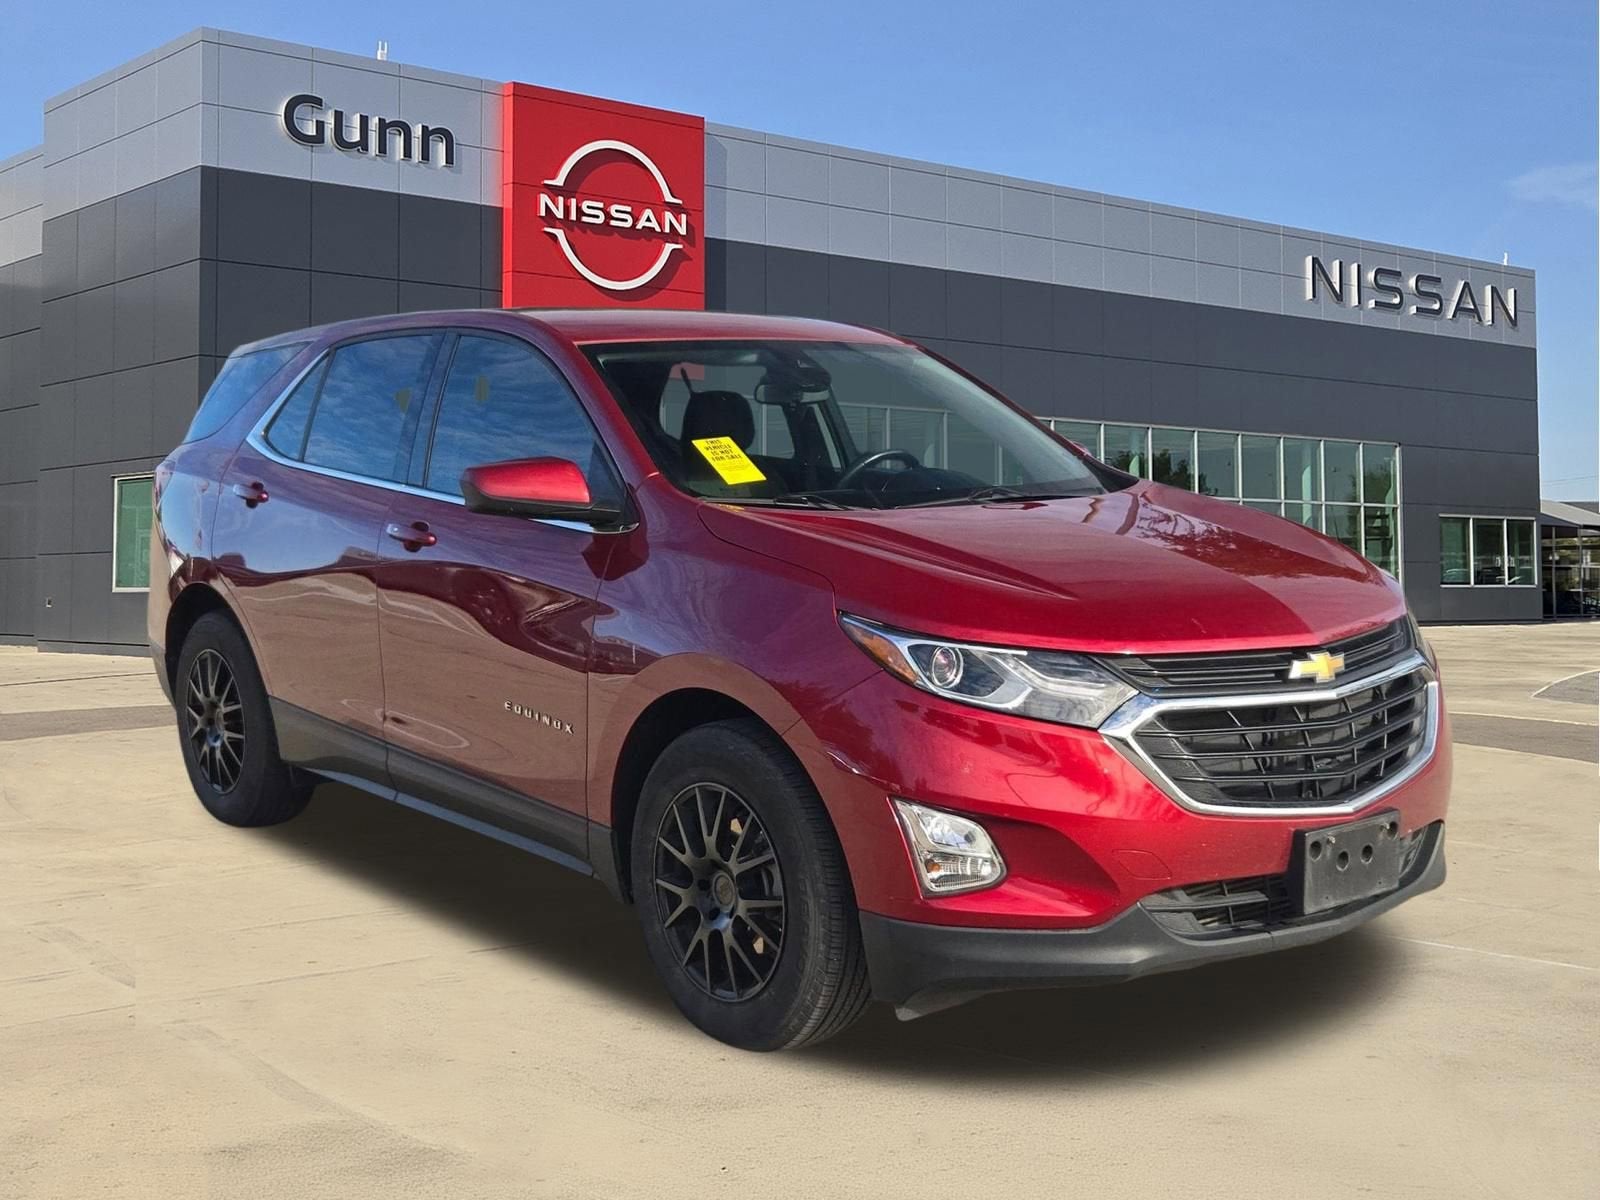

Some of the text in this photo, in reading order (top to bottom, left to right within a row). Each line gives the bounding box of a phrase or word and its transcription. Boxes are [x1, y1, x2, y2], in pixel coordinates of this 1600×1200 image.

[282, 93, 456, 168] Gunn
[537, 193, 688, 236] NISSAN
[1305, 255, 1518, 328] NISSAN
[504, 700, 574, 734] EQUINOX
